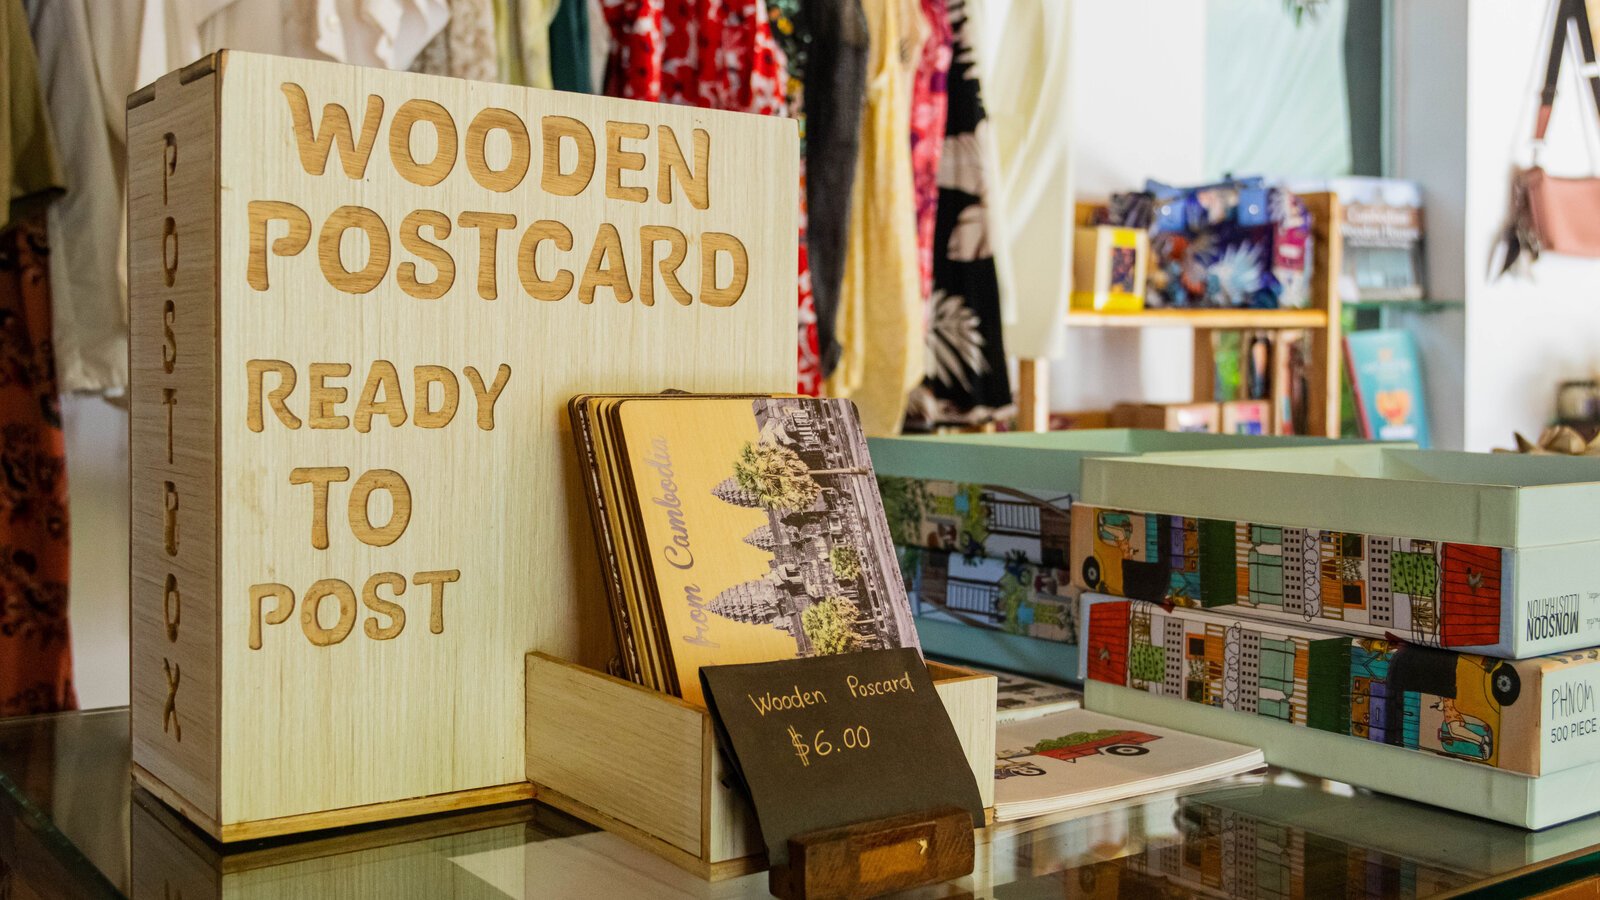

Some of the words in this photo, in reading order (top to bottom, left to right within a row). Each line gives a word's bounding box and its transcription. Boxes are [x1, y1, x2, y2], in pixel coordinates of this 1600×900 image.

[280, 82, 710, 210] WOODEN
[246, 200, 749, 308] POSTCARD
[246, 359, 512, 433] READY
[289, 466, 412, 550] TO
[648, 433, 694, 570] Cambodia
[248, 569, 461, 650] POST
[682, 583, 720, 649] from
[1526, 611, 1579, 642] MONSOON
[748, 685, 827, 716] Wooden
[846, 671, 915, 698] Poscard
[1551, 680, 1595, 720] PHNOM
[787, 725, 871, 767] $6.00
[1550, 725, 1569, 743] 500
[1571, 717, 1598, 738] PIECE
